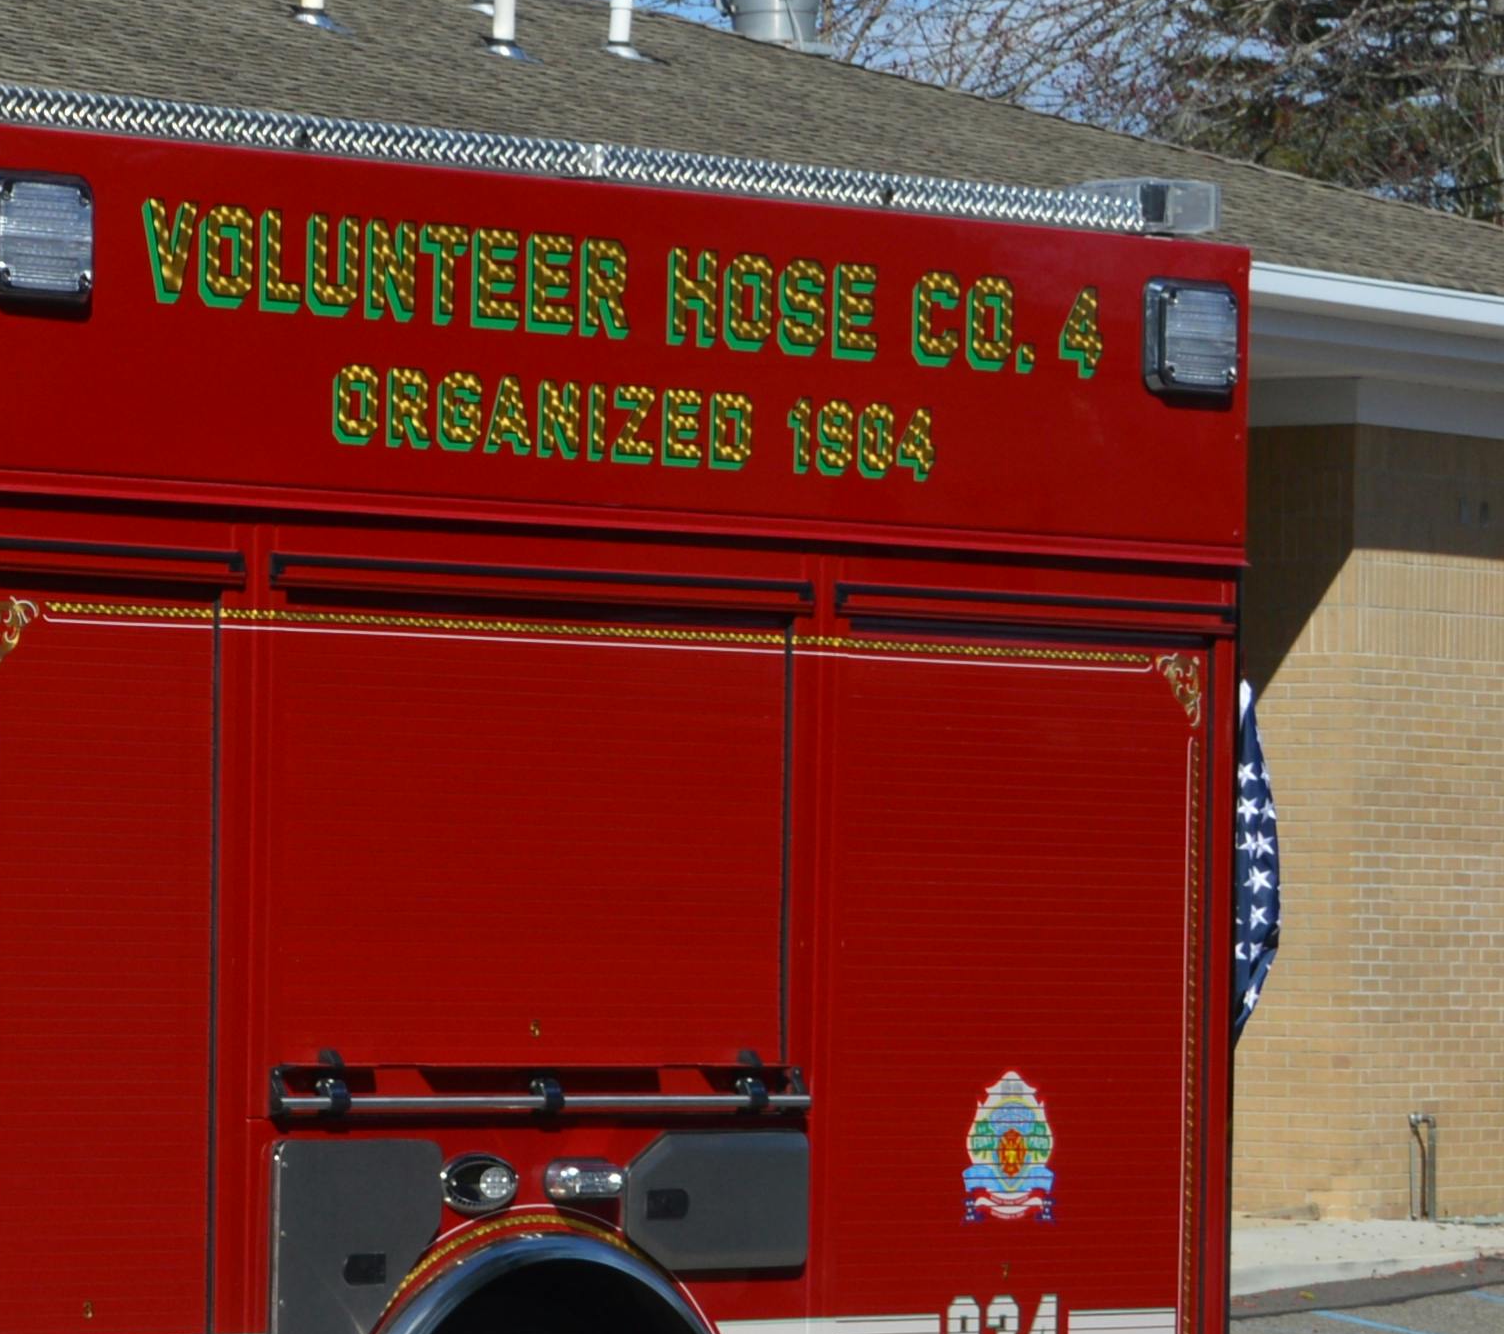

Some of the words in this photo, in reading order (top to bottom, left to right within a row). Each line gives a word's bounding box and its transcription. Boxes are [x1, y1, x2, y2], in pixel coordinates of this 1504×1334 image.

[141, 197, 630, 339] VOLUNTEER
[666, 247, 878, 361] HOSE
[911, 271, 1035, 374] CO.
[1057, 287, 1104, 379] 4
[332, 364, 755, 471] ORGANIZED
[787, 396, 936, 483] 1904
[82, 1300, 94, 1319] 3
